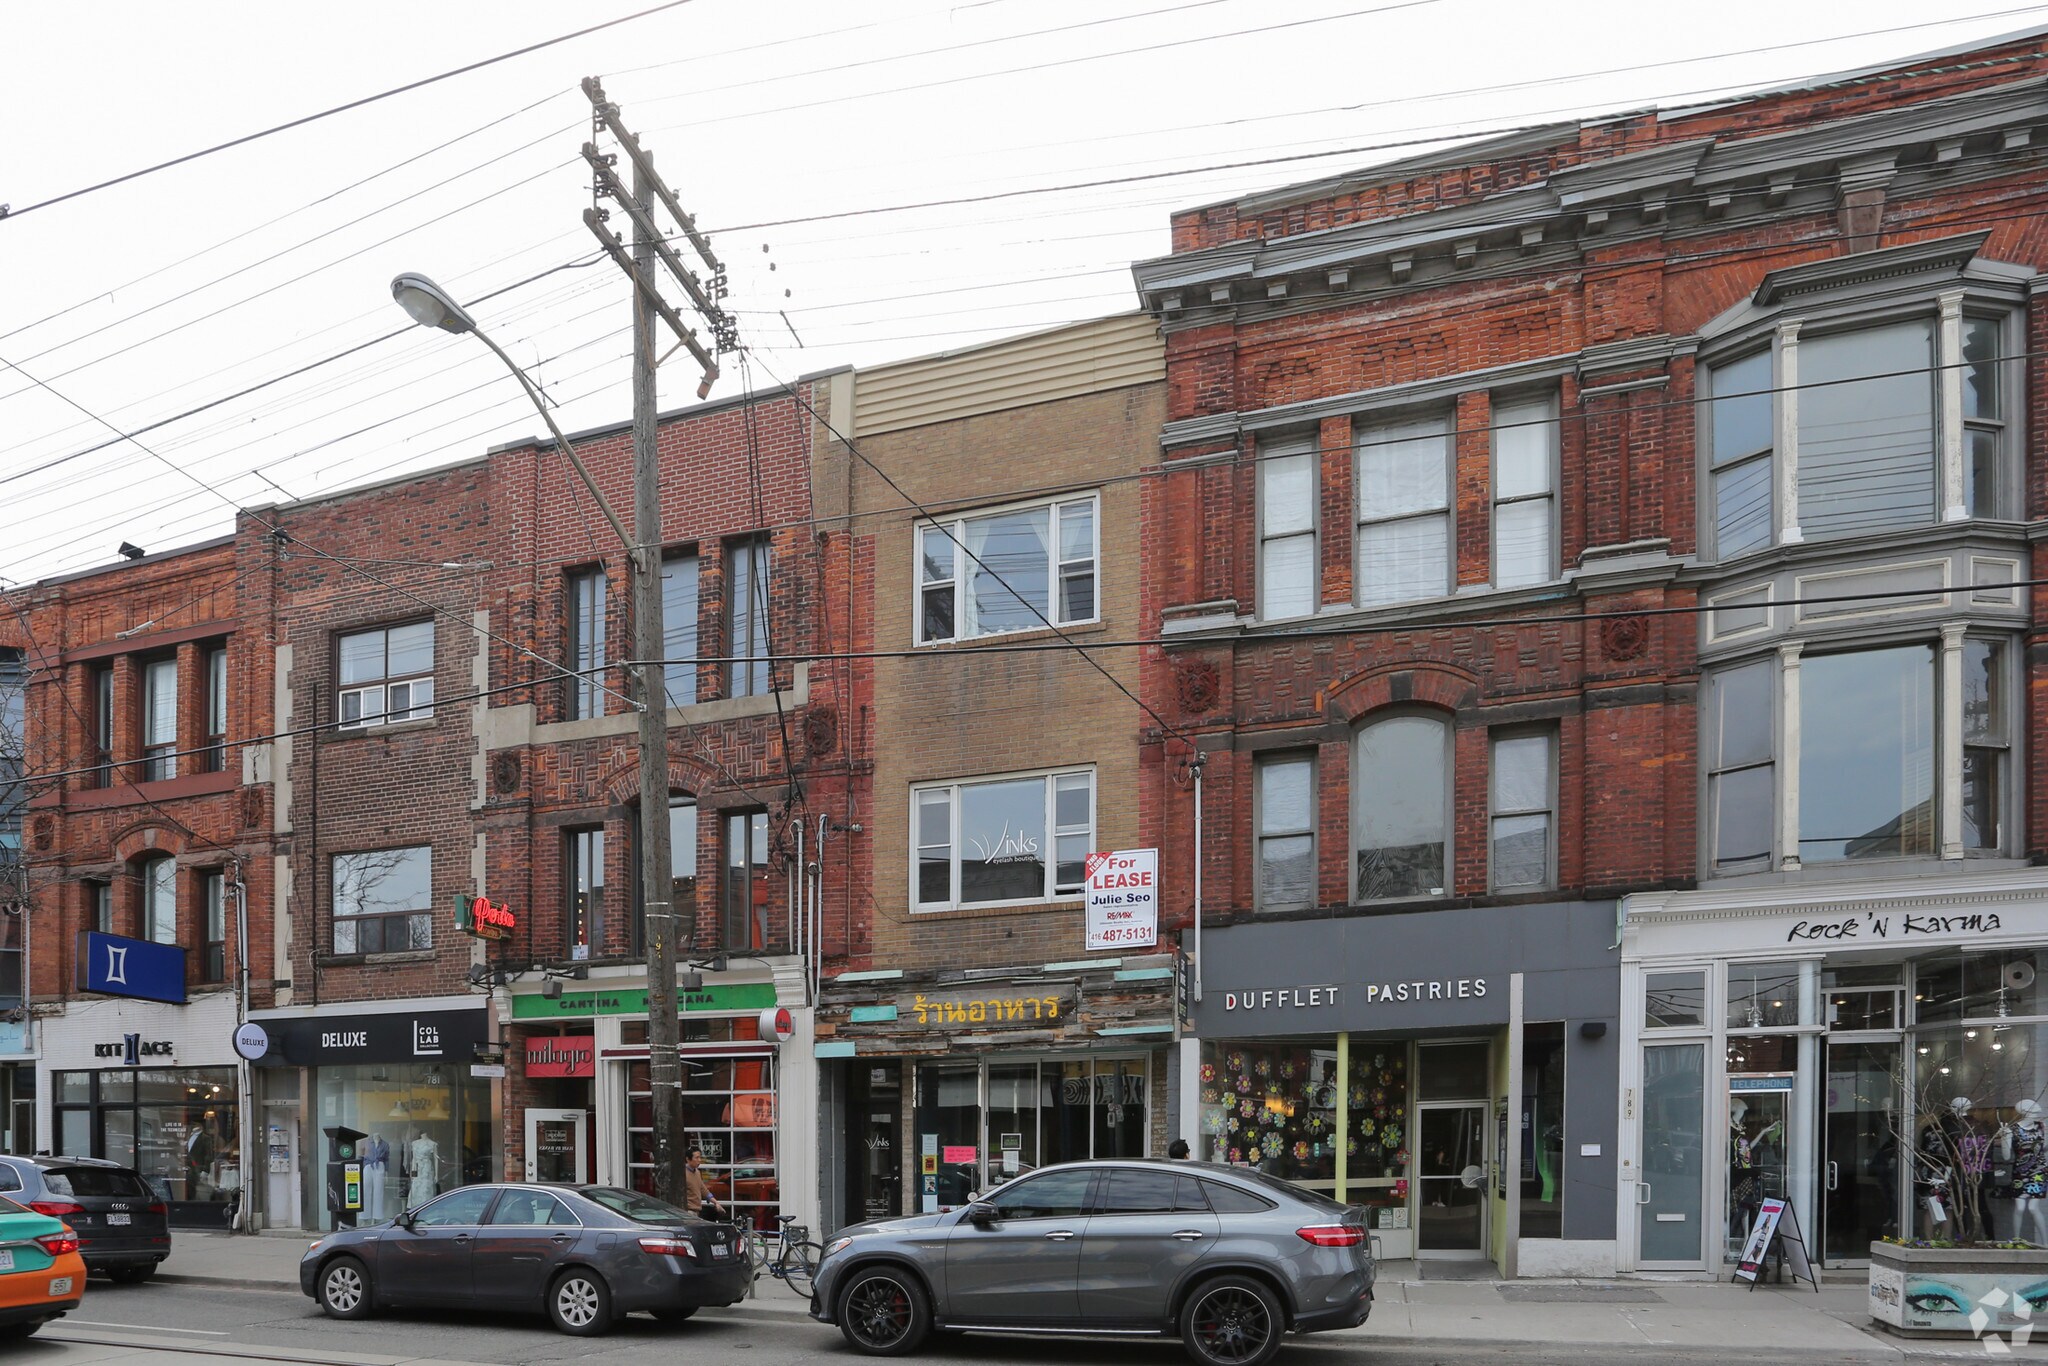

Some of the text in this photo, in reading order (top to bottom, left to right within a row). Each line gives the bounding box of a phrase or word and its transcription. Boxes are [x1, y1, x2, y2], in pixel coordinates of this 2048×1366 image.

[969, 819, 1039, 865] Winks
[992, 857, 1013, 866] eyelash
[1086, 854, 1098, 867] 2ND
[1089, 856, 1106, 873] FLOOR
[1108, 858, 1136, 870] For
[1093, 871, 1152, 890] LEASE
[1091, 893, 1151, 906] Julie Seo
[1106, 911, 1133, 920] RE/MAX
[1091, 927, 1152, 942] 416 487-5131
[1225, 978, 1487, 1011] DUFFLET PASTRIES
[559, 998, 621, 1010] CANTINA
[912, 993, 1060, 1024] ร้านอาหาร
[419, 1026, 439, 1035] COL
[242, 1037, 265, 1048] DELUXE
[321, 1031, 368, 1048] DELUXE
[419, 1035, 440, 1044] LAB
[94, 1041, 173, 1058] KIT ACE
[527, 1039, 593, 1075] milagro
[427, 1075, 440, 1085] 781
[1731, 1078, 1791, 1089] TELEPHONE
